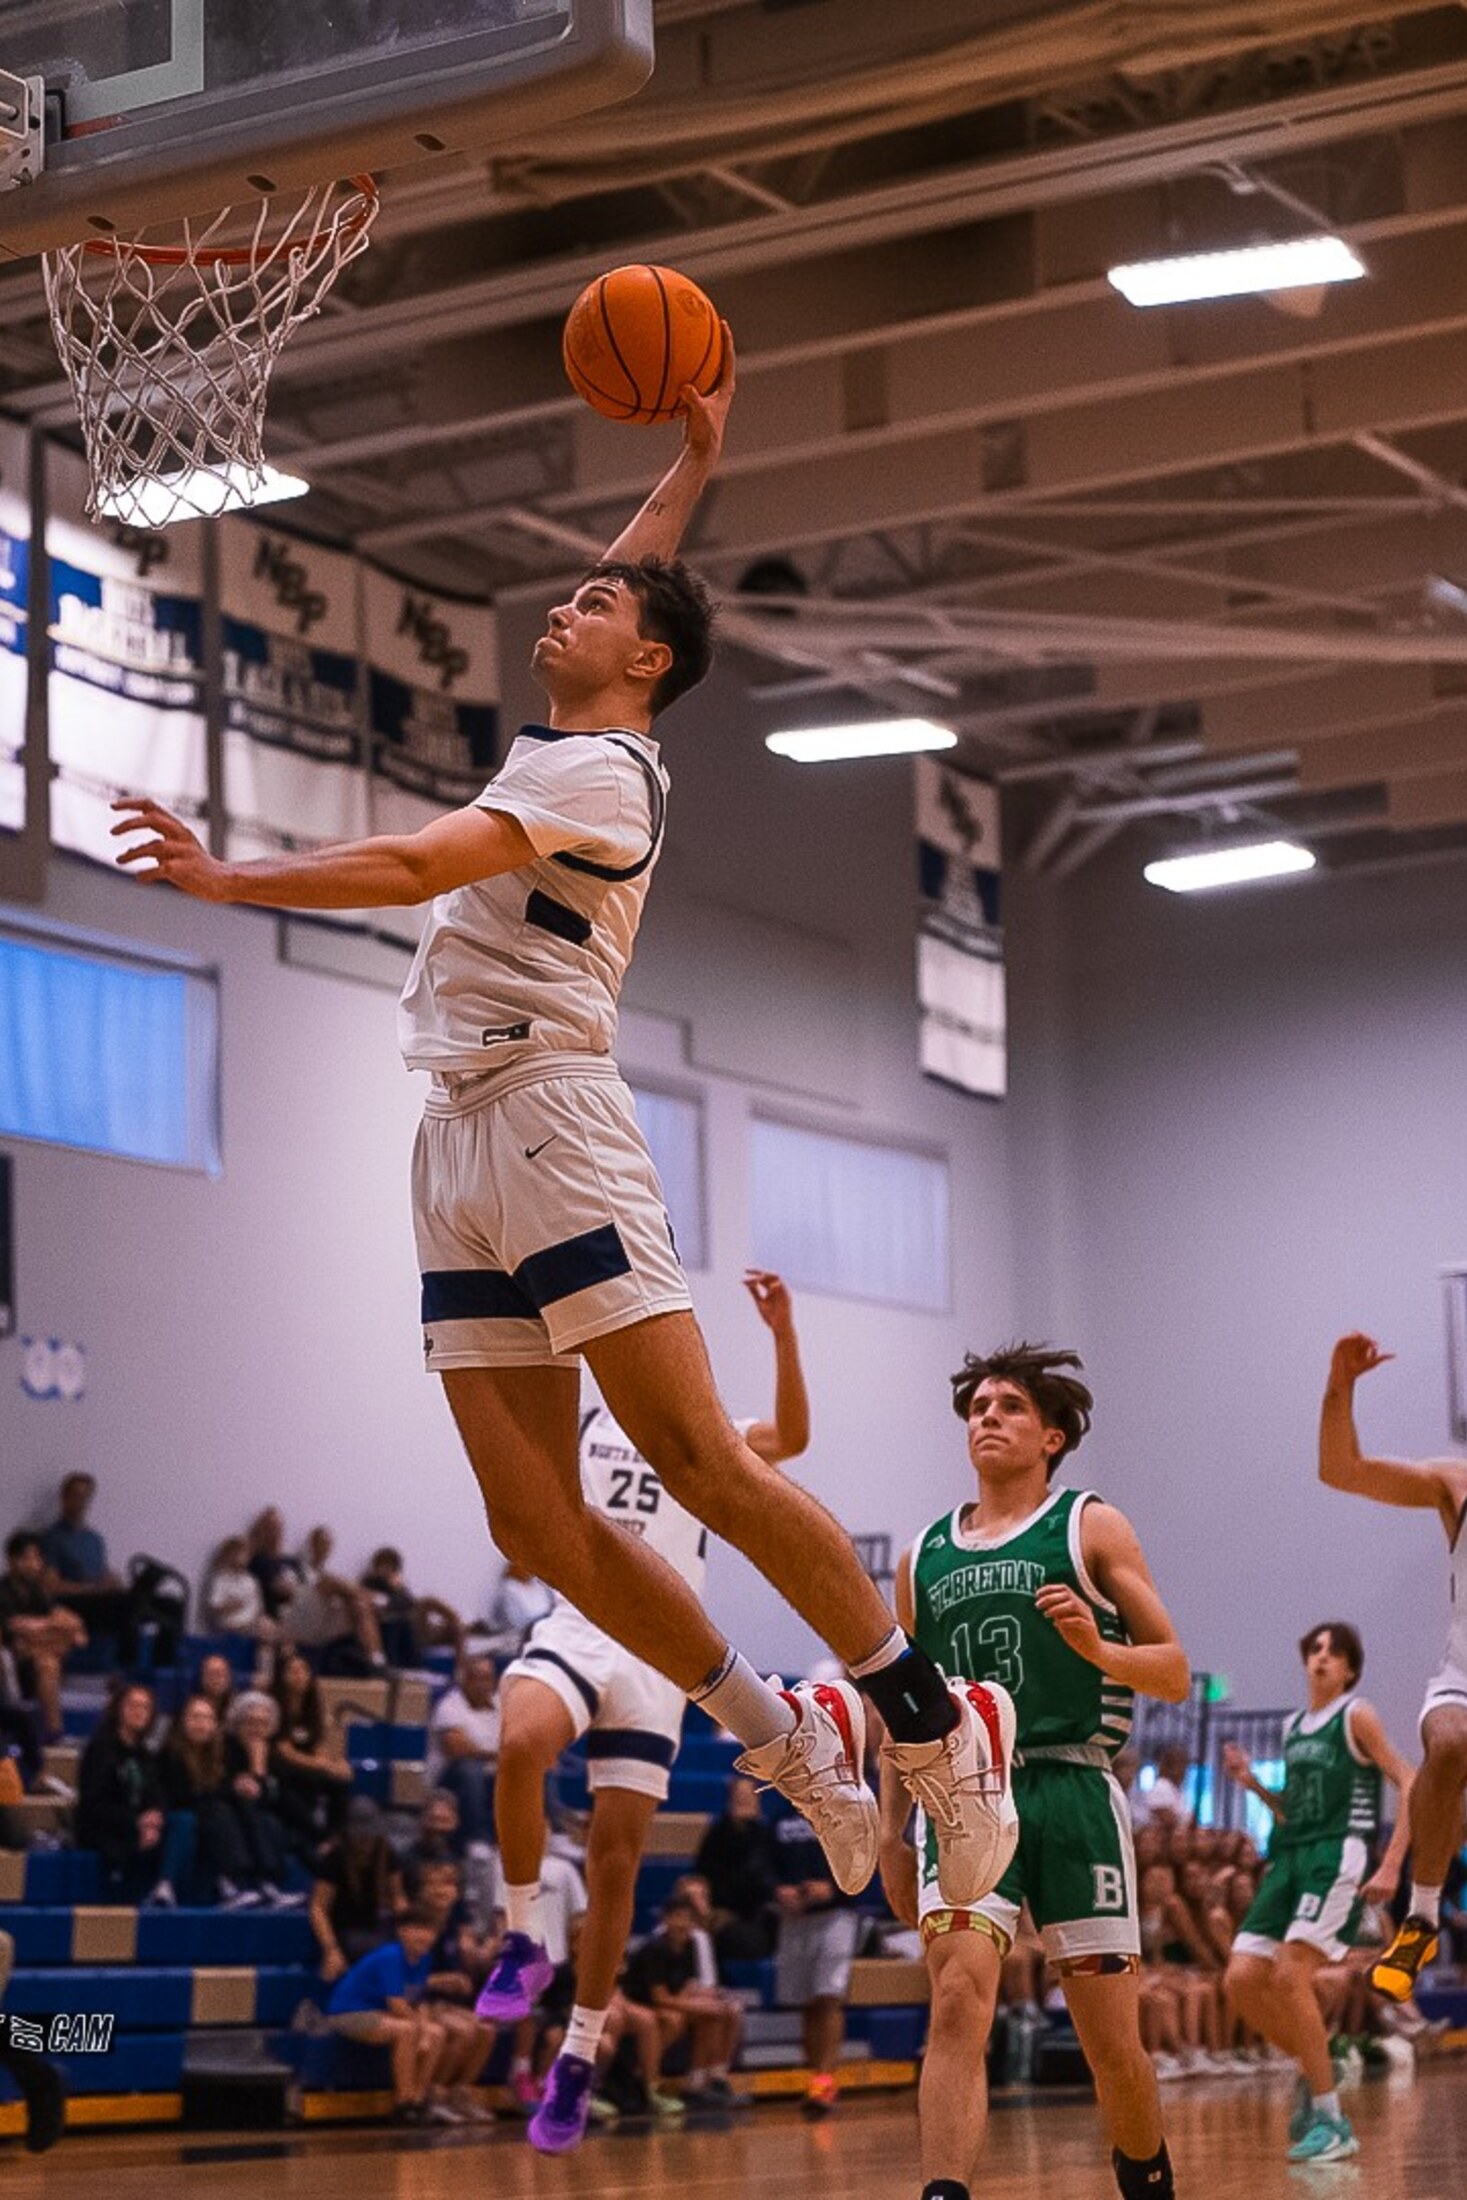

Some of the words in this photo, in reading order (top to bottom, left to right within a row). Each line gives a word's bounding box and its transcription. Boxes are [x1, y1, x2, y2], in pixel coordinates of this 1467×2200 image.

[607, 1468, 662, 1514] 25
[950, 1559, 1046, 1605] BRENDAN
[950, 1614, 1024, 1695] 13
[1091, 1864, 1123, 1911] B
